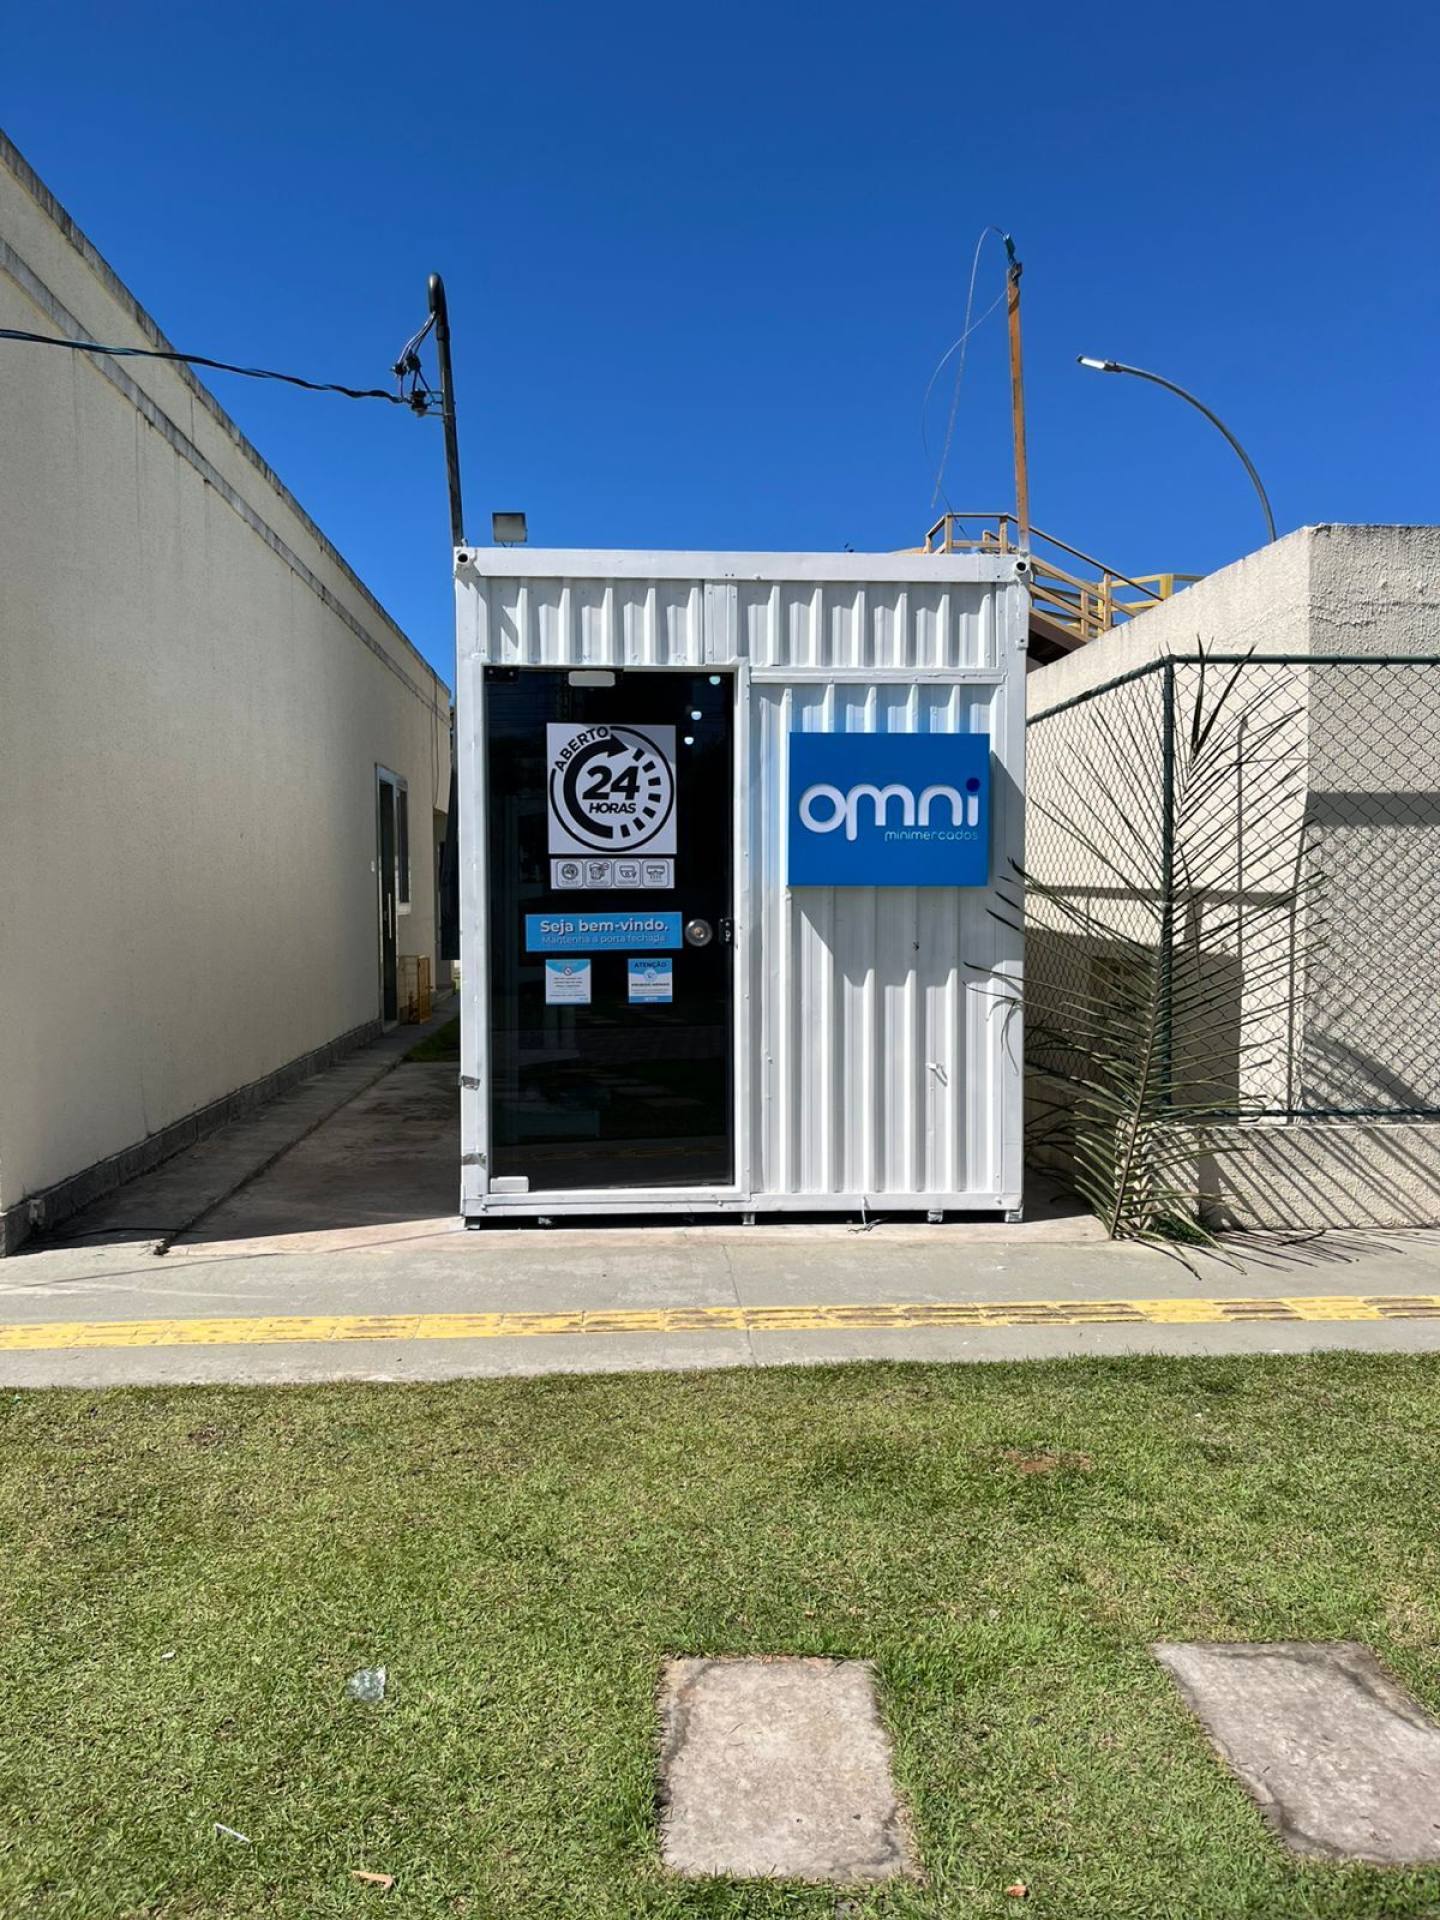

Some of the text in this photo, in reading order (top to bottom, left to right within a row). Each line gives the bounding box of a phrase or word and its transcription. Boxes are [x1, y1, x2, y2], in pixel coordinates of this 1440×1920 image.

[554, 726, 609, 773] ABERTO
[582, 764, 640, 801] 24
[588, 802, 637, 814] HORAS
[799, 777, 980, 841] omni
[884, 830, 979, 842] minimercados
[540, 918, 668, 935] Seja bem-vindo.
[600, 935, 626, 944] porta
[634, 960, 668, 969] ATENÇÃO
